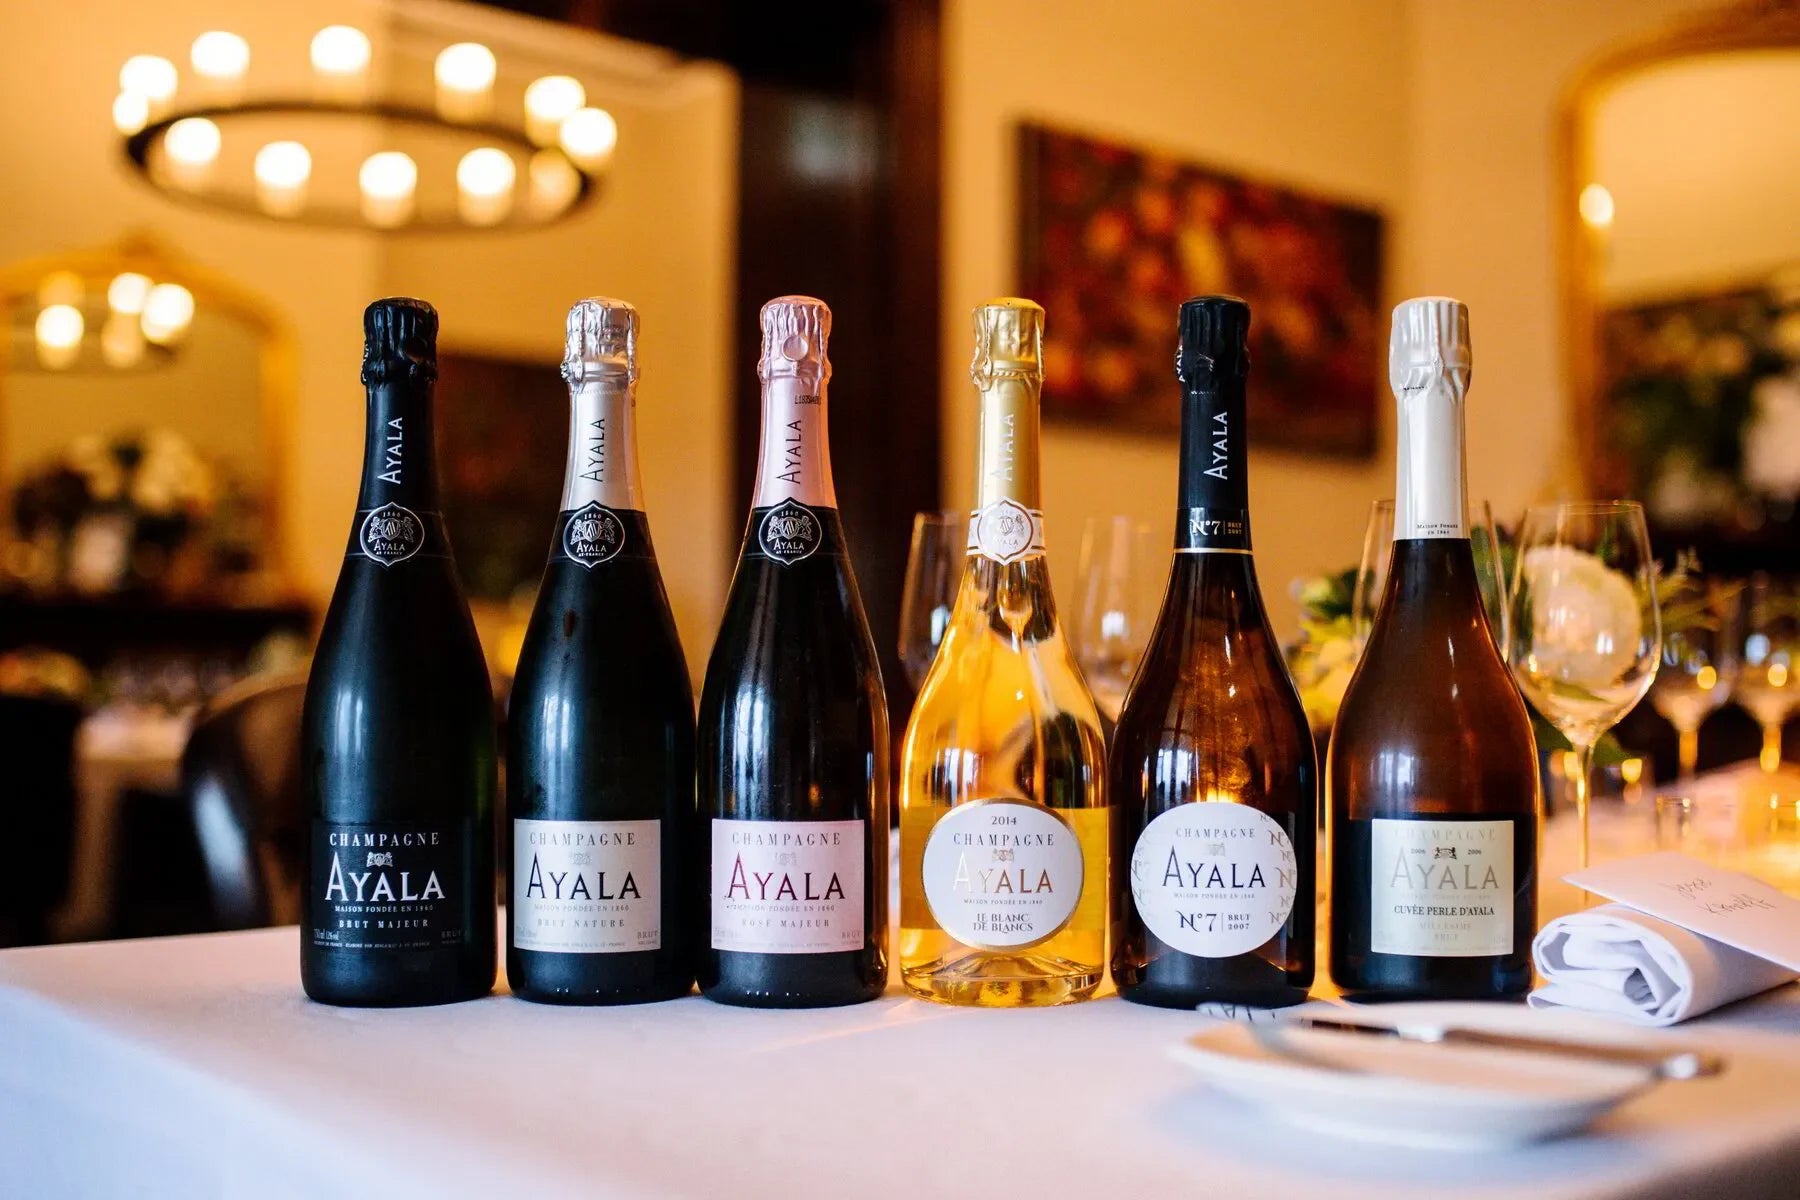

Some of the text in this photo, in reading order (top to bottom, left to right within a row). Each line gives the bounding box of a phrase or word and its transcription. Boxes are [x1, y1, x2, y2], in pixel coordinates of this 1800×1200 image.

[377, 417, 403, 485] AYALA
[579, 418, 605, 482] AYALA
[776, 420, 801, 485] AYALA
[992, 414, 1014, 482] AYALA
[1203, 411, 1228, 480] AYALA
[373, 538, 405, 551] AYALA
[576, 540, 607, 553] AYALA
[773, 538, 805, 551] AYALA
[991, 815, 1017, 826] 2014
[329, 832, 440, 847] CHAMPAGNE
[529, 832, 636, 846] CHAMPAGNE
[732, 832, 841, 846] CHAMPAGNE
[953, 832, 1055, 847] CHAMPAGNE
[1175, 827, 1257, 839] CHAMPAGNE
[953, 851, 1054, 894] AYALA
[1161, 845, 1266, 889] AYALA
[1390, 847, 1500, 890] AYALA
[324, 851, 446, 902] AYALA
[526, 851, 642, 900] AYALA
[728, 851, 846, 901] AYALA
[334, 904, 363, 913] MAISON
[401, 904, 412, 913] EN
[1394, 903, 1496, 916] CUVÉE PERLE D'AYALA
[339, 919, 429, 929] BRUT MAJEUR
[538, 918, 625, 928] BRUT NATURE
[780, 919, 830, 928] MAJEUR
[992, 912, 1030, 923] BLANC
[973, 922, 1033, 933] DE BLANCS
[1228, 923, 1250, 931] 2007
